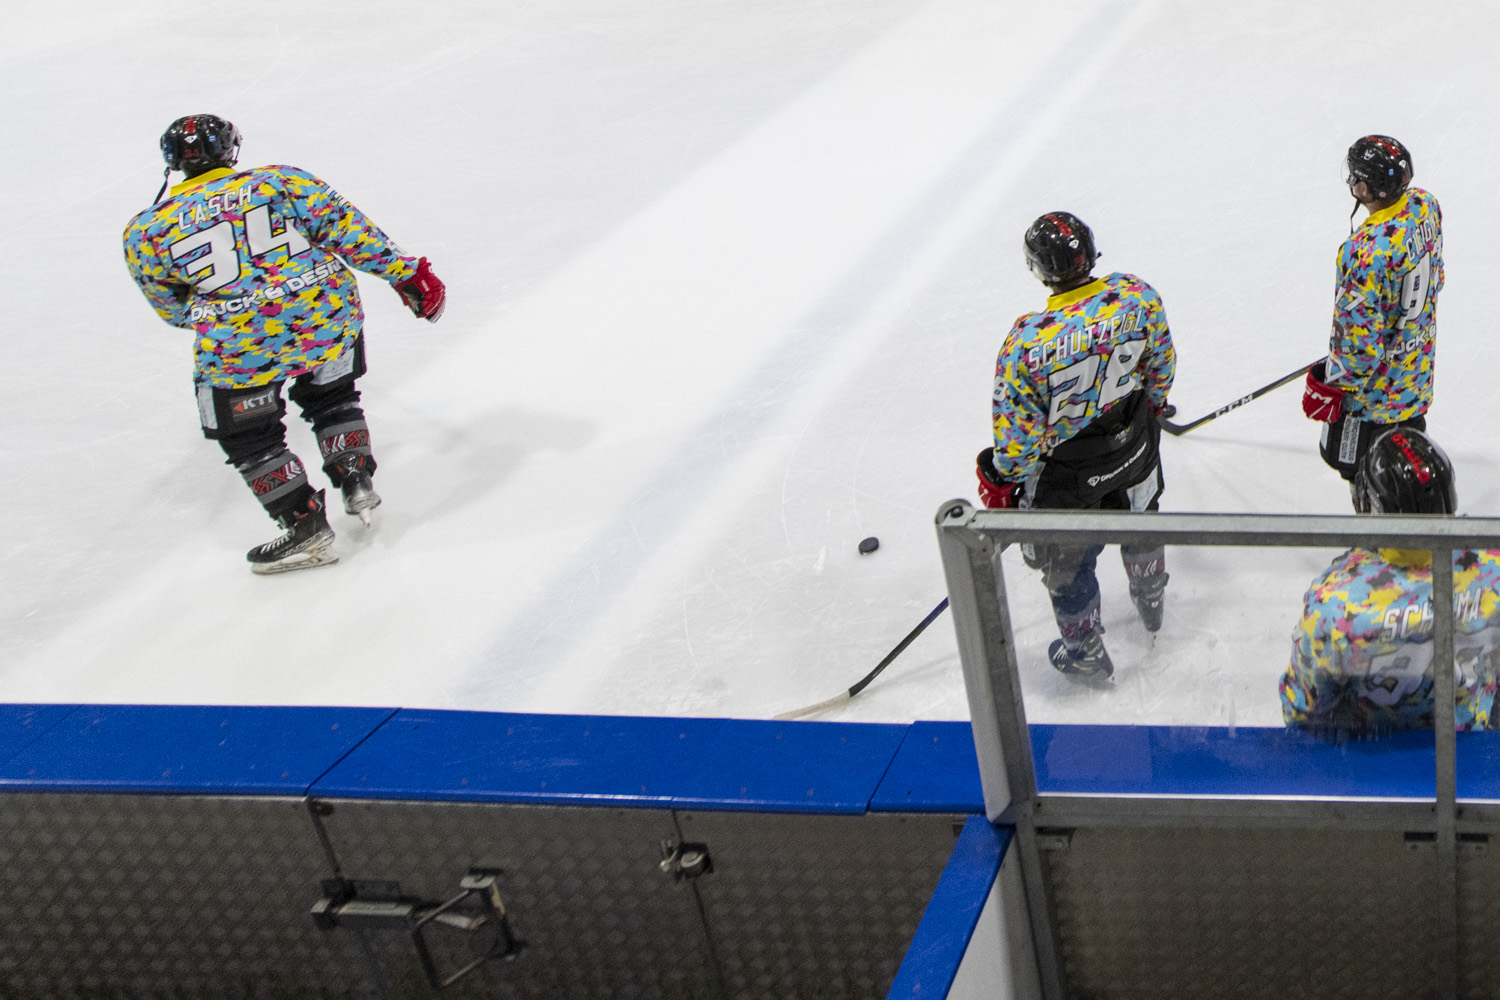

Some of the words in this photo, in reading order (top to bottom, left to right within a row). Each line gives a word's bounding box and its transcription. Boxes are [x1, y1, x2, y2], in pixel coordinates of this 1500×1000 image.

[178, 184, 253, 231] LASCH
[169, 203, 312, 295] 34
[190, 295, 262, 322] DRUCK
[264, 285, 285, 300] &
[1028, 308, 1143, 374] SCHUTZEIGL
[1047, 337, 1148, 426] 28
[1214, 393, 1254, 419] CCM
[1379, 587, 1482, 644] SCHMA
